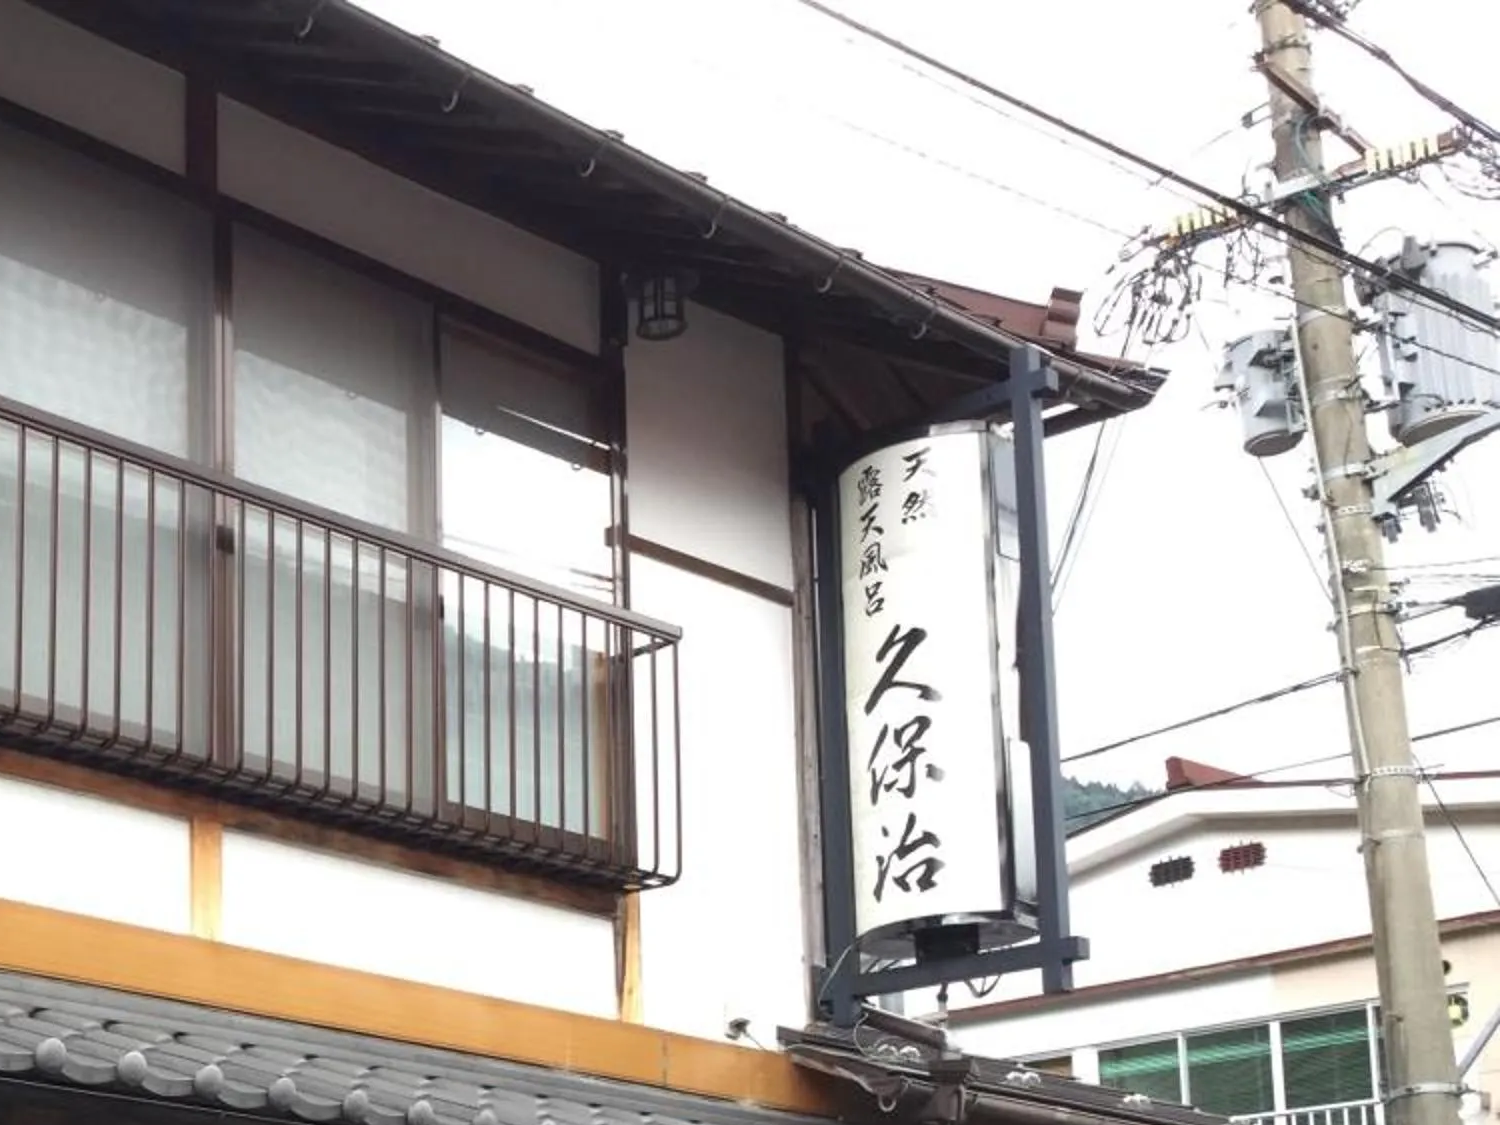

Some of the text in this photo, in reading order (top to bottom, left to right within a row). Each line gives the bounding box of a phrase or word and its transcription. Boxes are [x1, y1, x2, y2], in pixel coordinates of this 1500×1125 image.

[857, 466, 889, 617] 露天風呂
[902, 446, 933, 524] 天然
[864, 623, 945, 902] 久保治
